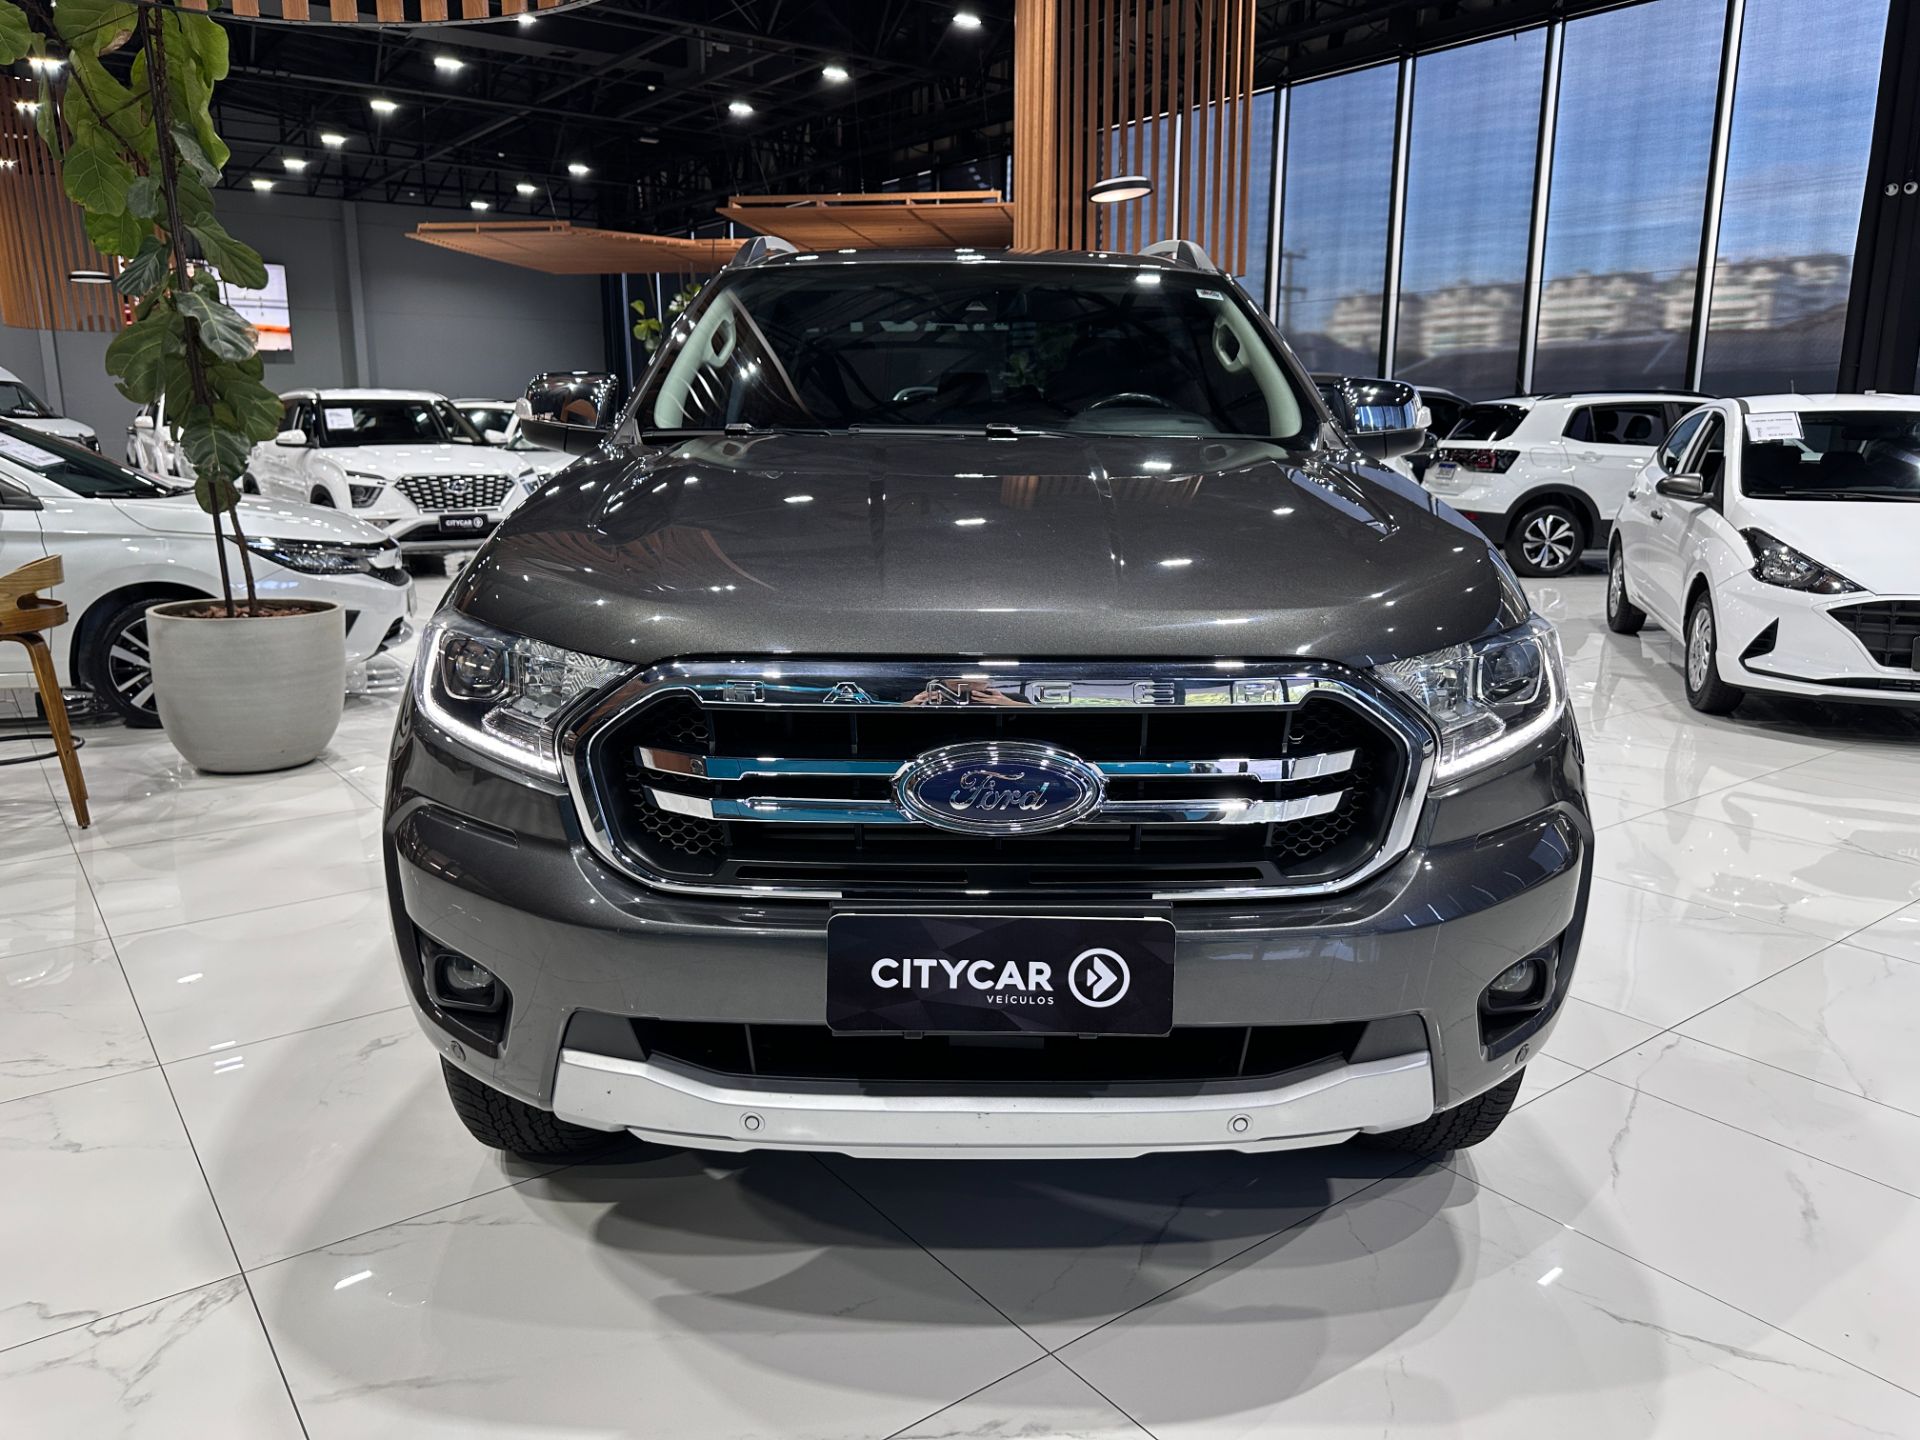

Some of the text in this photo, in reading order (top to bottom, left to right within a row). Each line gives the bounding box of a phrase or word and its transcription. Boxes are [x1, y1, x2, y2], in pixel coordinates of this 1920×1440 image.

[723, 680, 1281, 705] RANGER
[949, 769, 1050, 811] Ford
[870, 957, 1054, 992] CITYCAR
[986, 993, 1054, 1006] VEÍCULOS
